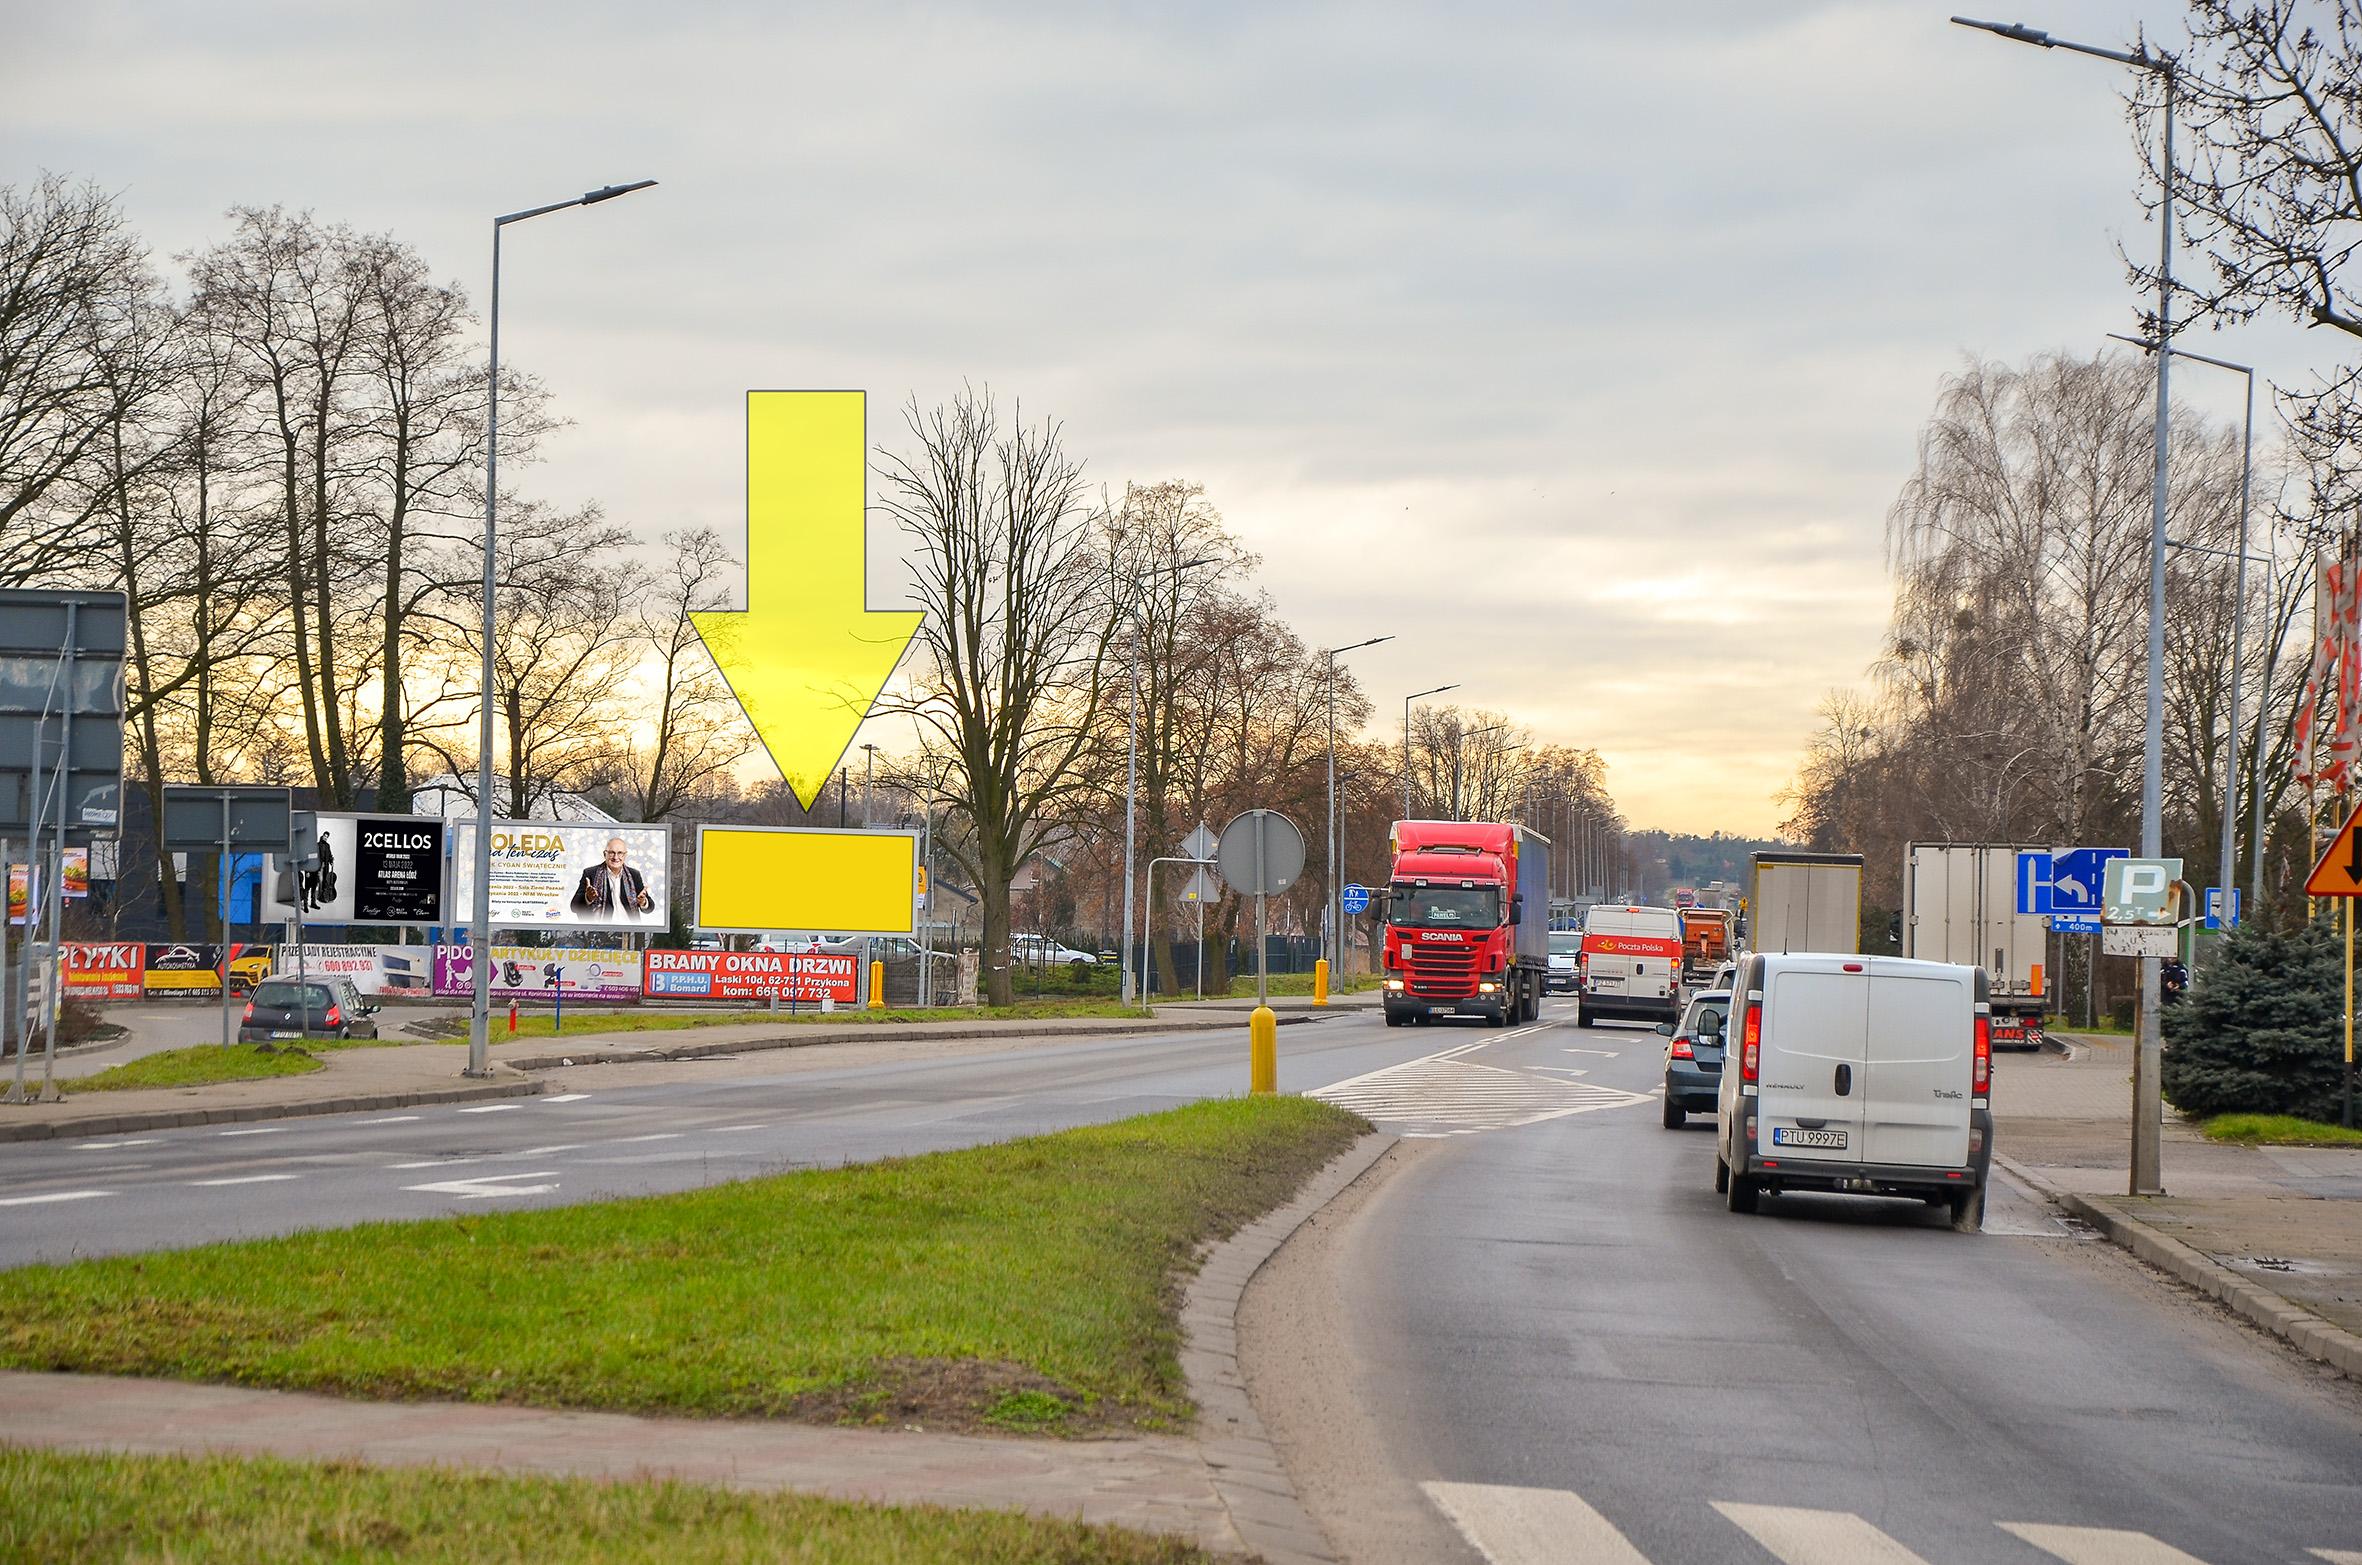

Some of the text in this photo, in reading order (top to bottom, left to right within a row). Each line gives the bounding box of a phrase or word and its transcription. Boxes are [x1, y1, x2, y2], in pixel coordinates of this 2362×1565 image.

[364, 832, 432, 849] 2CELLOS
[491, 833, 565, 853] OLĘDA
[506, 843, 527, 859] ten
[530, 849, 560, 861] czas
[391, 870, 405, 879] ARENA
[2120, 865, 2166, 904] P
[2069, 923, 2093, 931] 400m
[1421, 932, 1463, 941] SCANIA
[321, 946, 378, 958] REJESTRACYJNE
[1618, 943, 1663, 952] Poczta Polska
[57, 945, 138, 970] PŁYTKI
[490, 948, 639, 965] ARTYKUŁY DZIECIĘCE
[324, 960, 340, 972] 600
[341, 960, 360, 972] 892
[649, 954, 851, 975] BRAMY OKNA DRZWI
[671, 975, 707, 985] P.P.H.U.
[715, 974, 849, 988] Laski 10d, 62-731 Przykona
[670, 984, 706, 993] Bomard
[723, 985, 831, 999] kom: 665 097 732
[1993, 1028, 2025, 1040] ANS
[1933, 1089, 1963, 1099] Trafic
[1781, 1130, 1845, 1146] PTU 9997E
